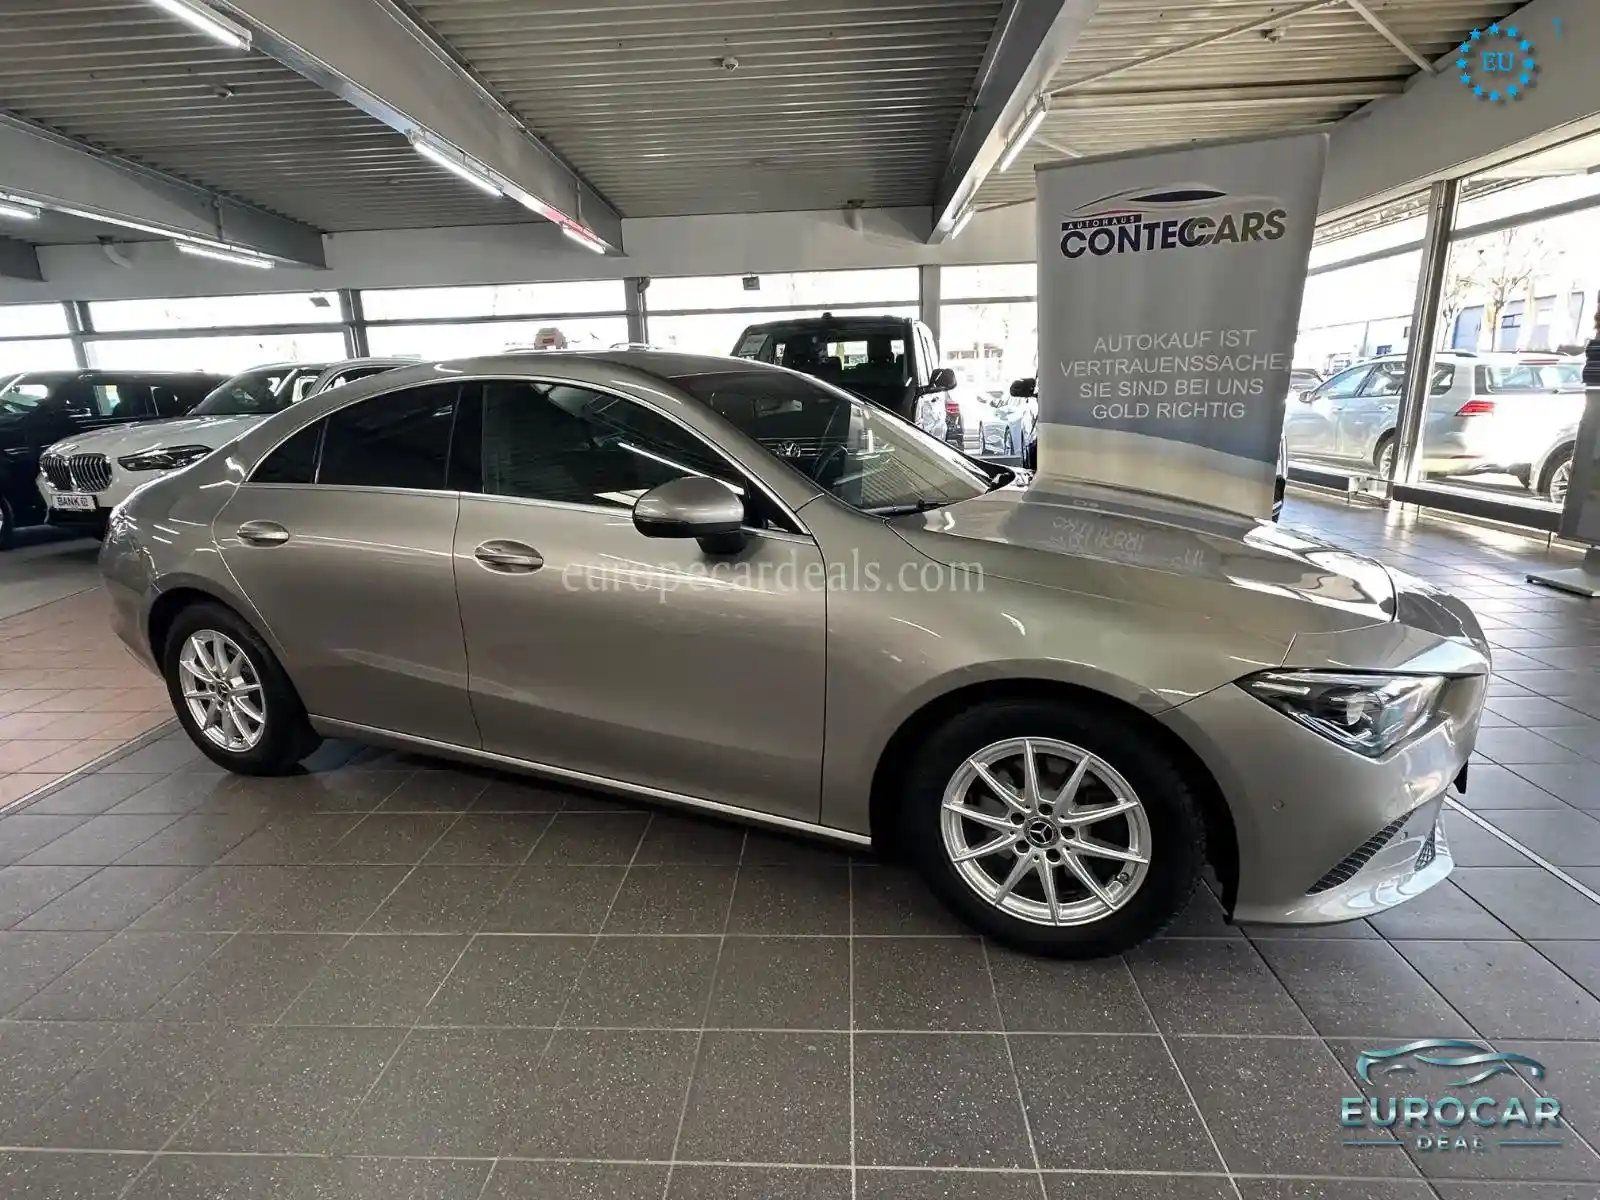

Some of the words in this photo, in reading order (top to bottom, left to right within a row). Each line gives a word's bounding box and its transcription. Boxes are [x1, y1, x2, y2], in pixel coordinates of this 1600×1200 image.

[1068, 216, 1135, 230] AUTOHAUS
[1094, 330, 1212, 353] AUTOKAUF
[1220, 329, 1256, 347] IST
[1079, 381, 1111, 398] SIE
[1118, 380, 1168, 396] SIND
[1174, 379, 1209, 395] BEI
[1217, 378, 1263, 395] UNS
[1093, 404, 1150, 419] GOLD
[1156, 402, 1245, 418] RICHTIG
